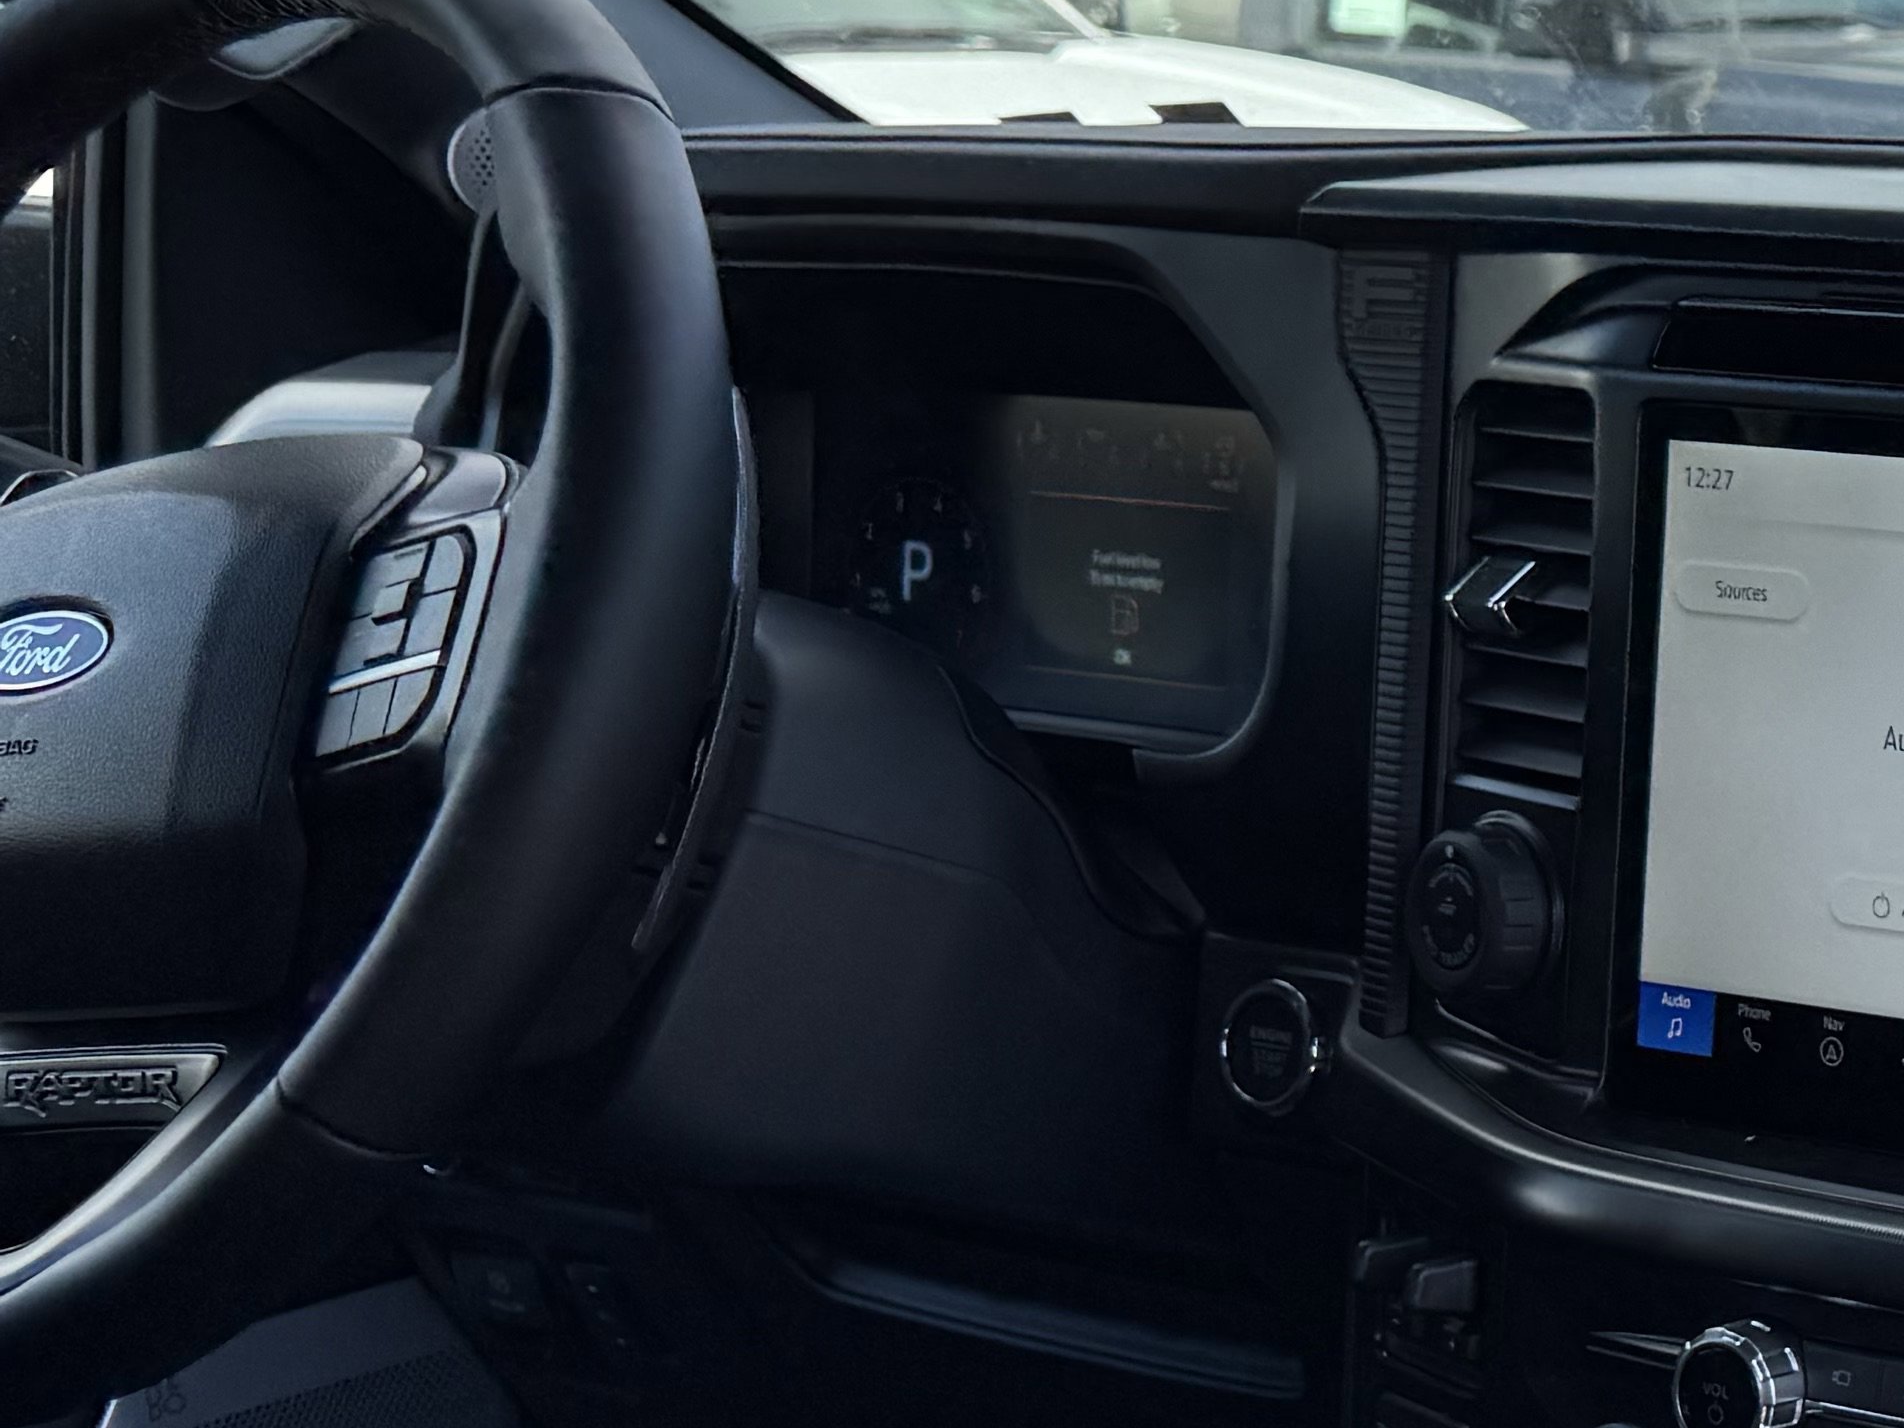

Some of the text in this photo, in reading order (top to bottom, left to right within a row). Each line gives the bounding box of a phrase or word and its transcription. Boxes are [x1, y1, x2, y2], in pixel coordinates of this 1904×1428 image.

[1684, 466, 1734, 490] 12:27
[902, 539, 934, 602] P
[1715, 580, 1768, 602] Sources
[0, 623, 81, 676] Ford
[1661, 991, 1691, 1009] Audio
[1737, 1003, 1771, 1022] Phone
[1823, 1015, 1846, 1032] Nav
[4, 1066, 184, 1118] RAPTOR
[1702, 1382, 1729, 1401] VOL
